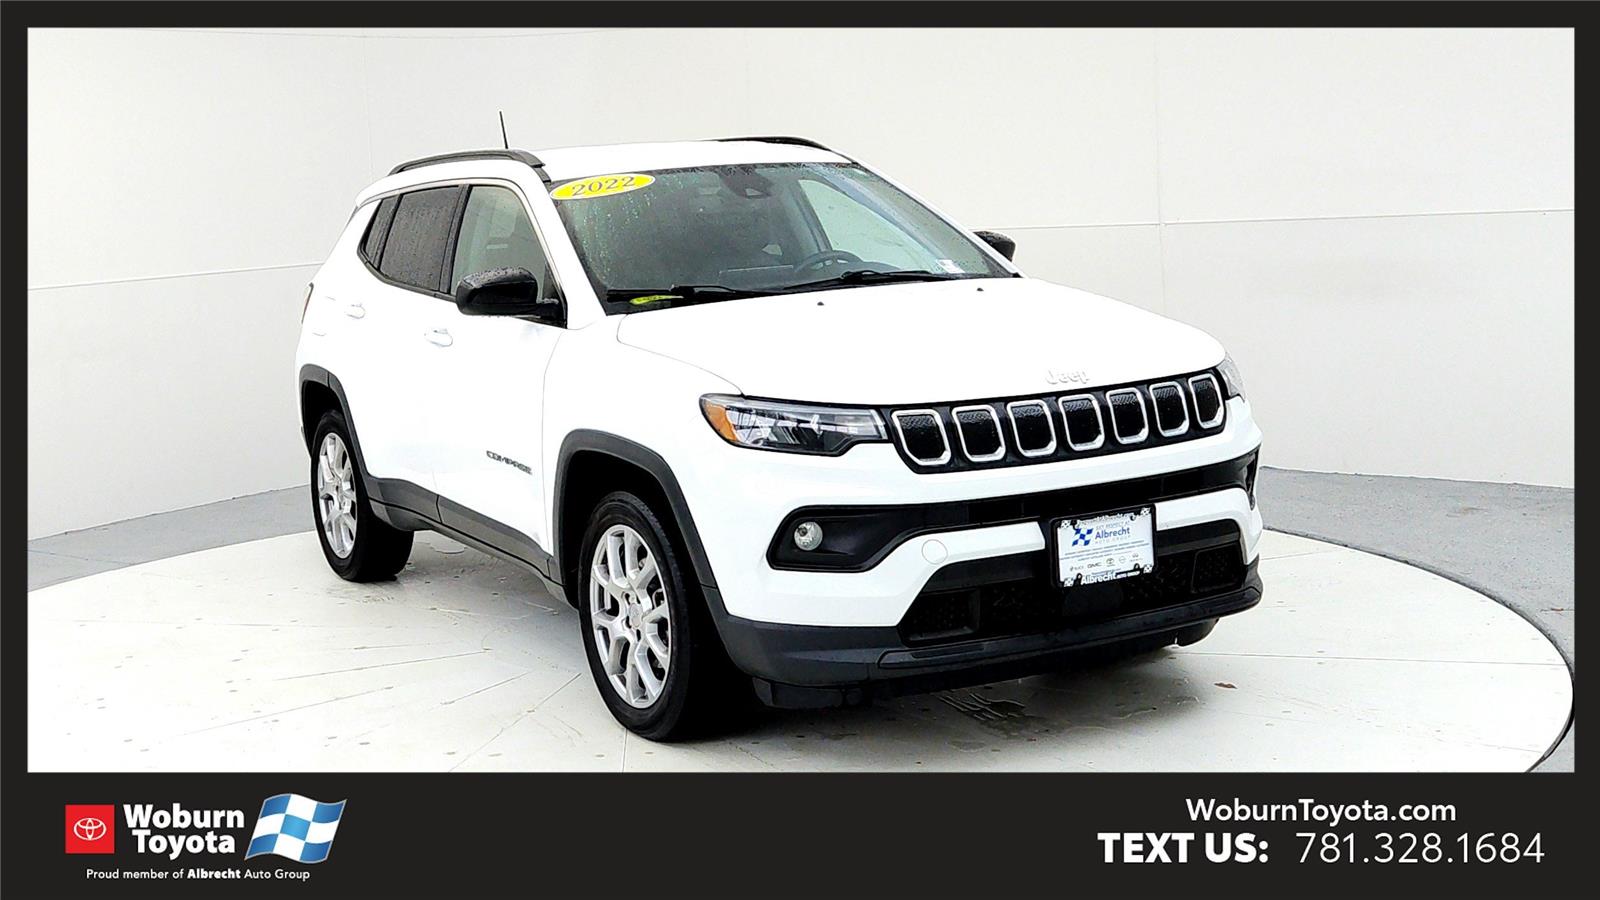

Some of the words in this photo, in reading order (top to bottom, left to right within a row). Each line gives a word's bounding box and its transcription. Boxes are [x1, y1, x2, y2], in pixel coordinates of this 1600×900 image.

[571, 176, 635, 196] 2022
[1046, 370, 1090, 385] Jeep
[1095, 527, 1130, 540] Albrecht
[1080, 571, 1117, 585] Albrecht
